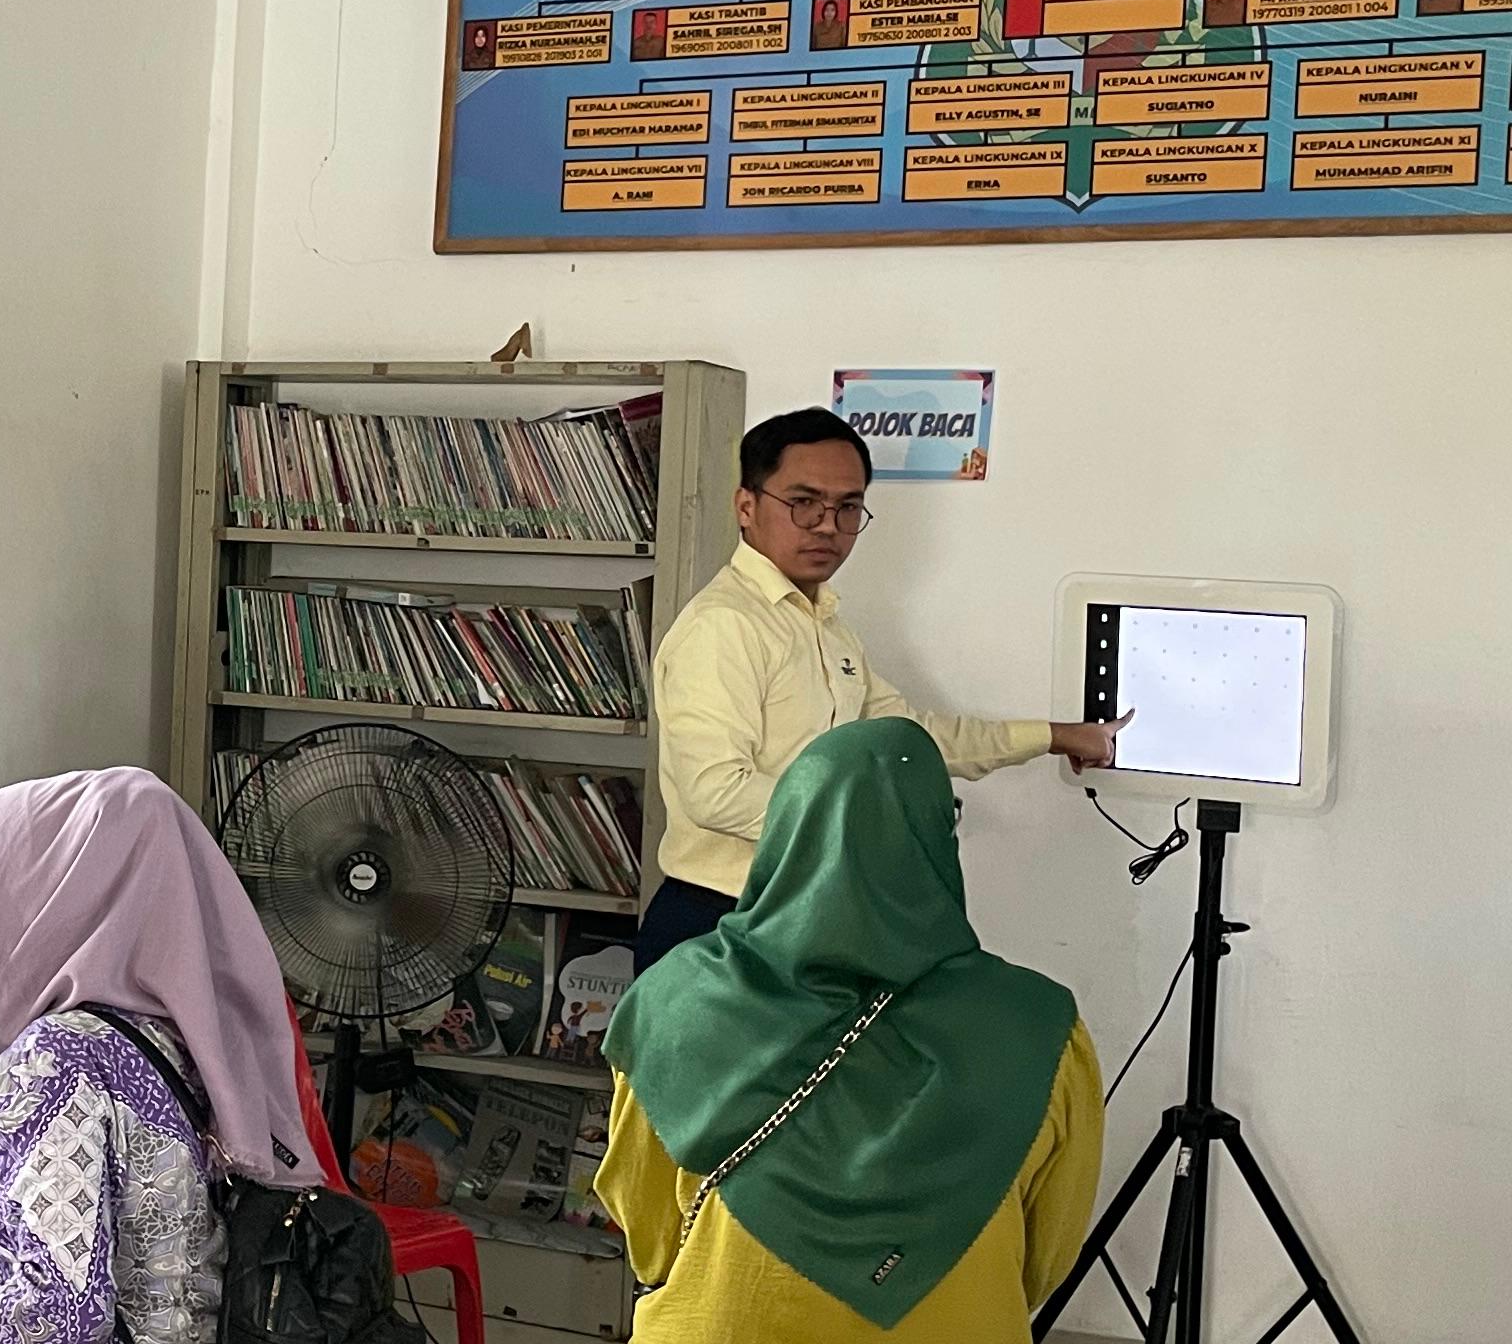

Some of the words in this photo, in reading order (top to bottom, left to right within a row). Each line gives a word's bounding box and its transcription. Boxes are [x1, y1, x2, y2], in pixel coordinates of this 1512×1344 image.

[689, 11, 714, 21] KASI
[718, 7, 767, 19] TRANTIB
[1364, 1, 1389, 13] 004
[500, 23, 524, 34] KASI
[526, 18, 607, 32] PEMERINTAHAN
[871, 16, 903, 27] ESTER
[952, 26, 972, 37] 003
[763, 37, 784, 48] 002
[1306, 65, 1361, 77] KEPALA
[1365, 61, 1460, 75] LINGKUNGAN
[1464, 60, 1476, 70] V
[1102, 76, 1153, 87] KEPALA
[1158, 71, 1246, 85] LINGKUNGAN
[1250, 70, 1265, 80] IV
[915, 85, 963, 96] KEPALA
[966, 81, 1049, 94] LINGKUNGAN
[1053, 80, 1065, 89] III
[742, 94, 787, 104] KEPALA
[790, 90, 868, 102] LINGKUNGAN
[871, 90, 879, 98] II
[1358, 91, 1418, 102] NURAINI
[575, 102, 617, 112] KEPALA
[620, 99, 693, 110] LINGKUNGAN
[935, 112, 963, 121] ELLY
[1026, 107, 1041, 117] SE
[572, 129, 590, 137] EDI
[592, 126, 646, 136] MUCHTAR
[648, 123, 703, 134] HARAHAP
[1300, 140, 1355, 151] KEPALA
[1359, 136, 1453, 150] LINGKUNGAN
[1458, 135, 1471, 145] XI
[913, 154, 960, 164] KEPALA
[964, 151, 1047, 163] LINGKUNGAN
[1050, 151, 1063, 159] IX
[1101, 148, 1152, 158] KEPALA
[1156, 144, 1244, 156] LINGKUNGAN
[1248, 143, 1258, 153] X
[566, 167, 608, 177] KEPALA
[611, 165, 684, 176] LINGKUNGAN
[686, 164, 702, 173] VII
[740, 162, 780, 172] KEPALA
[783, 159, 854, 170] LINGKUNGAN
[856, 158, 874, 167] VIII
[1315, 166, 1402, 178] MUHAMMAD
[1405, 164, 1453, 175] ARIFIN
[1145, 172, 1207, 183] SUSANTO
[742, 188, 766, 196] JON
[768, 185, 821, 195] RICARDO
[824, 184, 864, 194] PURBA
[849, 411, 918, 437] POJOK
[917, 412, 976, 438] BACA
[567, 975, 630, 996] STUNTI
